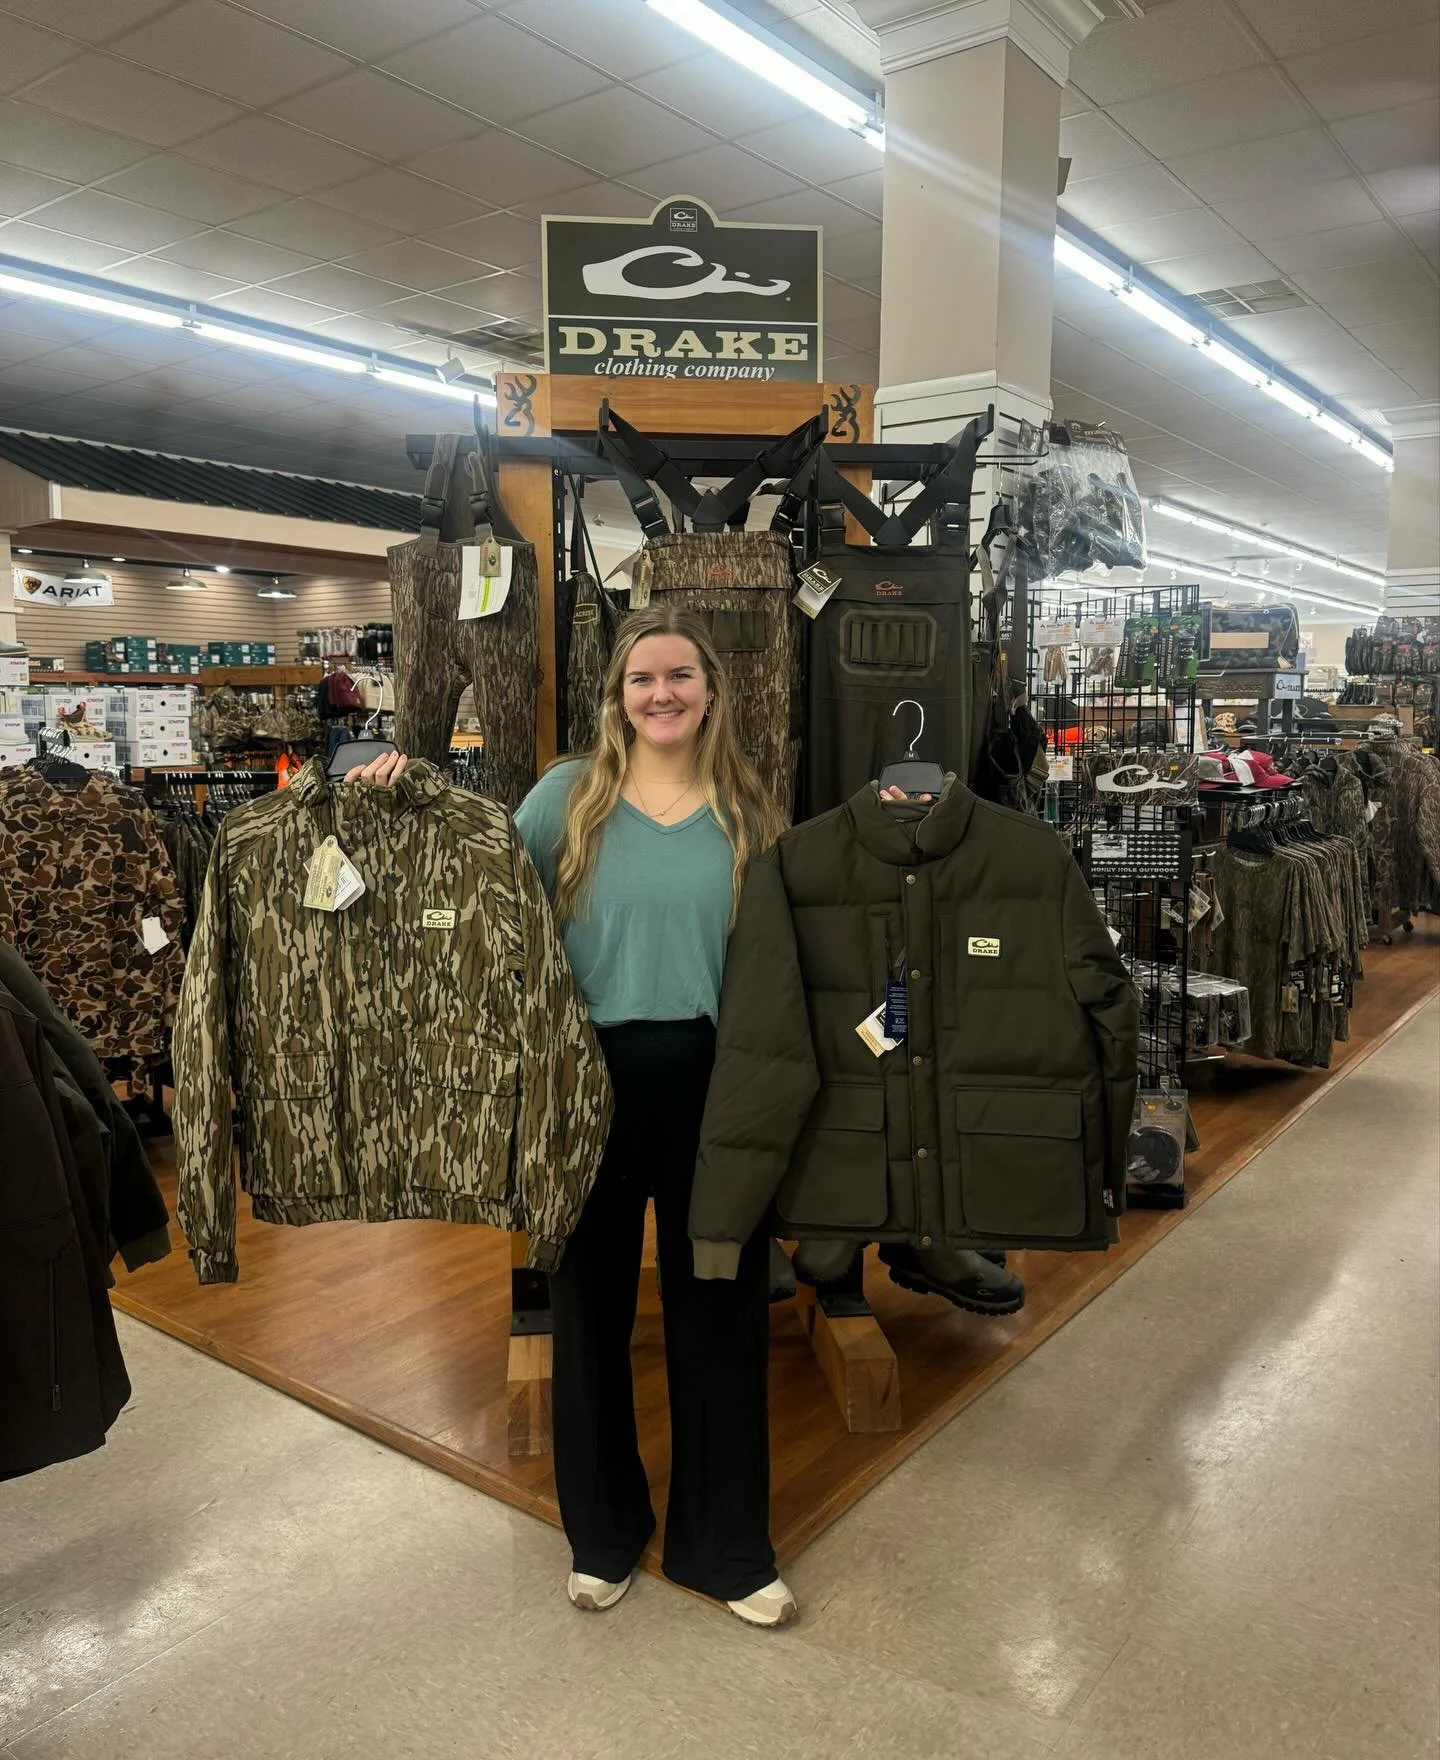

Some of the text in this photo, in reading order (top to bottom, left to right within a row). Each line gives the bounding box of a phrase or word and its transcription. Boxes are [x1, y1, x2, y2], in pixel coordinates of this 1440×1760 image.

[558, 326, 809, 361] DRAKE
[594, 357, 775, 382] clothing company
[42, 585, 102, 598] ARIAT
